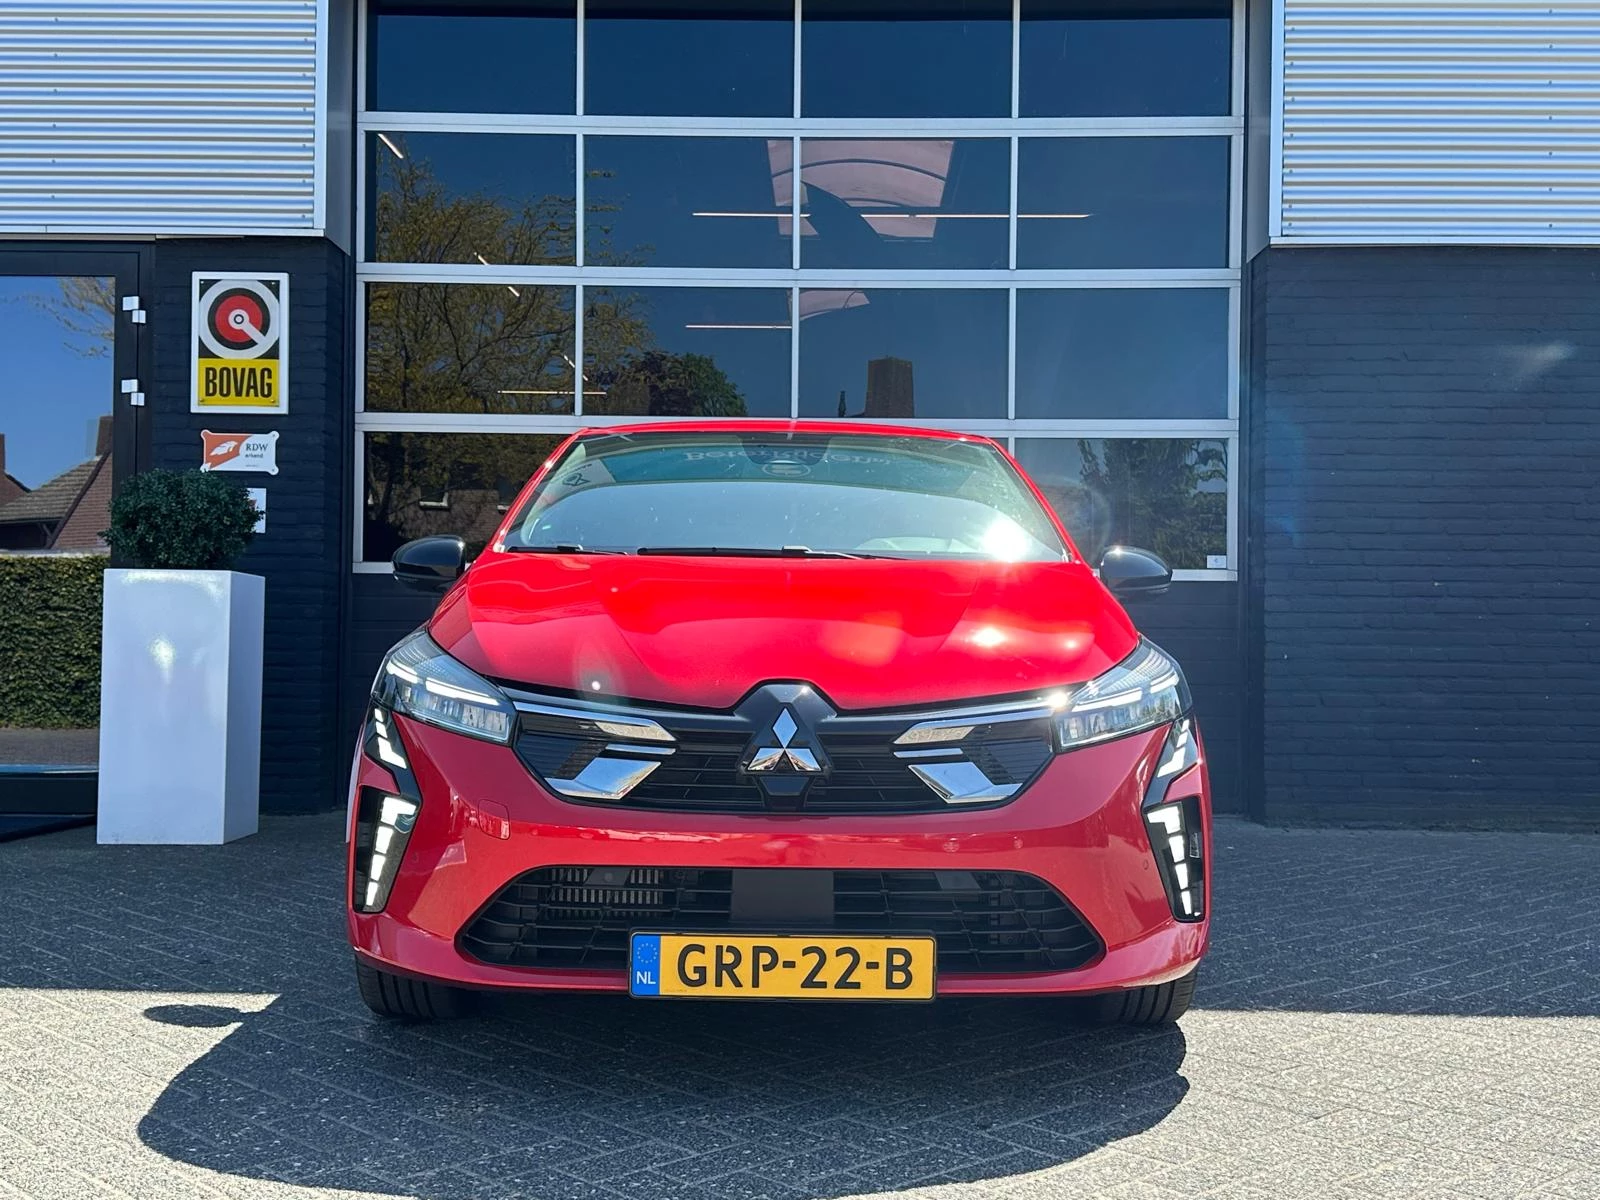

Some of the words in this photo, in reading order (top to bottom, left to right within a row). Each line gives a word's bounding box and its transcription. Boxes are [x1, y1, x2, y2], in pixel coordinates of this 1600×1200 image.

[205, 366, 273, 399] BOVAG
[245, 443, 268, 452] RDW
[636, 971, 656, 985] NL
[677, 943, 913, 990] GRP-22-B
